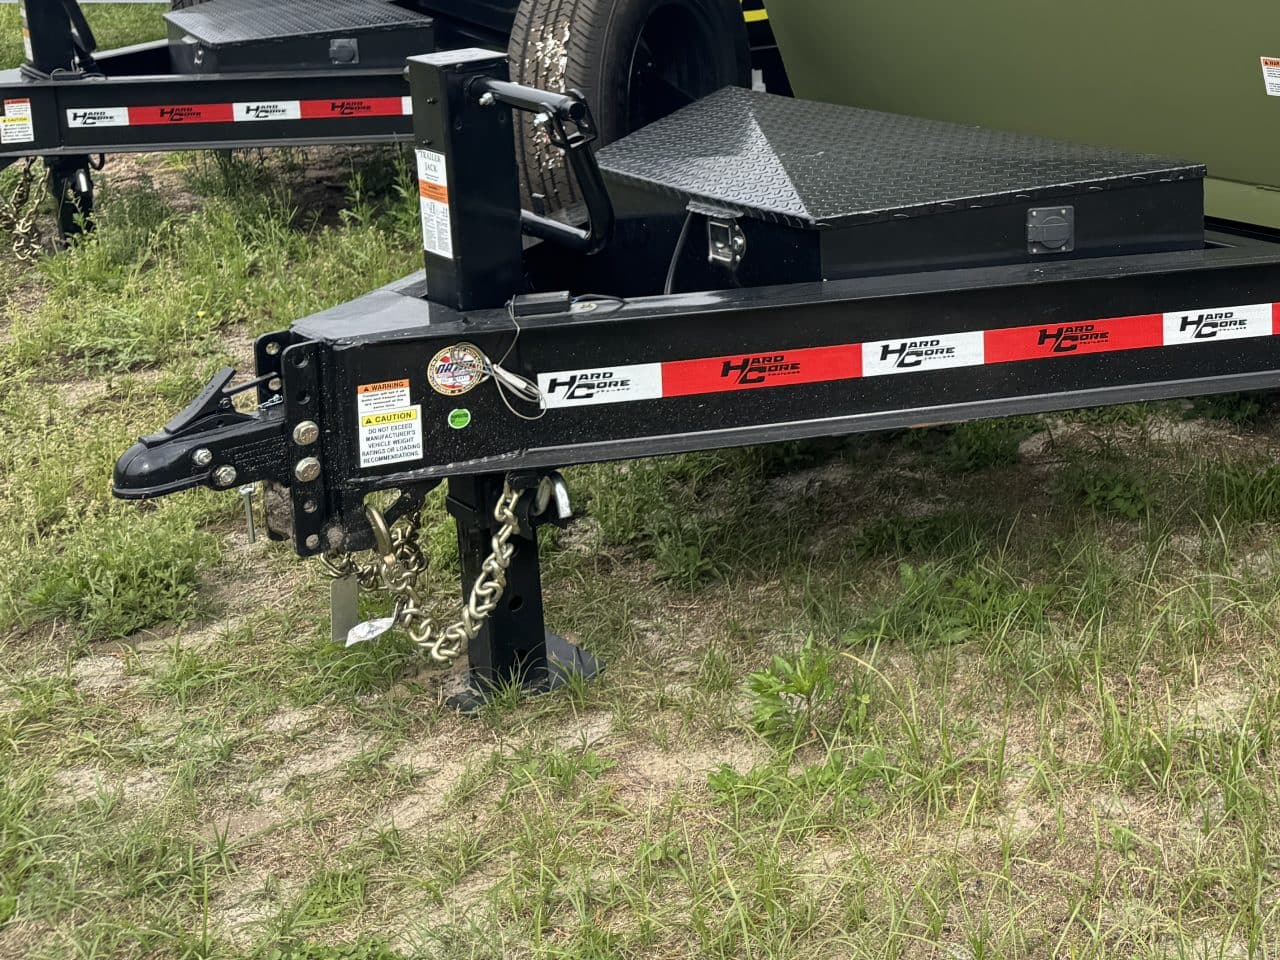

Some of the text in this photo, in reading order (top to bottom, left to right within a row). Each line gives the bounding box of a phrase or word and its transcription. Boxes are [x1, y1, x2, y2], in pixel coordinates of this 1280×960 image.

[418, 151, 441, 163] TRAILER
[424, 161, 437, 172] JACK
[1180, 312, 1233, 332] HARD
[1194, 319, 1247, 338] CORE
[1038, 325, 1094, 345] HARD
[1053, 332, 1109, 352] CORE
[880, 340, 940, 360] HARD
[896, 347, 955, 368] CORE
[720, 355, 784, 377] HARD
[738, 363, 800, 384] CORE
[372, 382, 404, 391] WARNING
[547, 372, 613, 393] HARD
[566, 380, 631, 399] CORE
[375, 412, 412, 423] CAUTION
[391, 423, 413, 431] EXCEED
[366, 430, 416, 441] MANUFACTURER'S
[396, 443, 420, 451] LOADING
